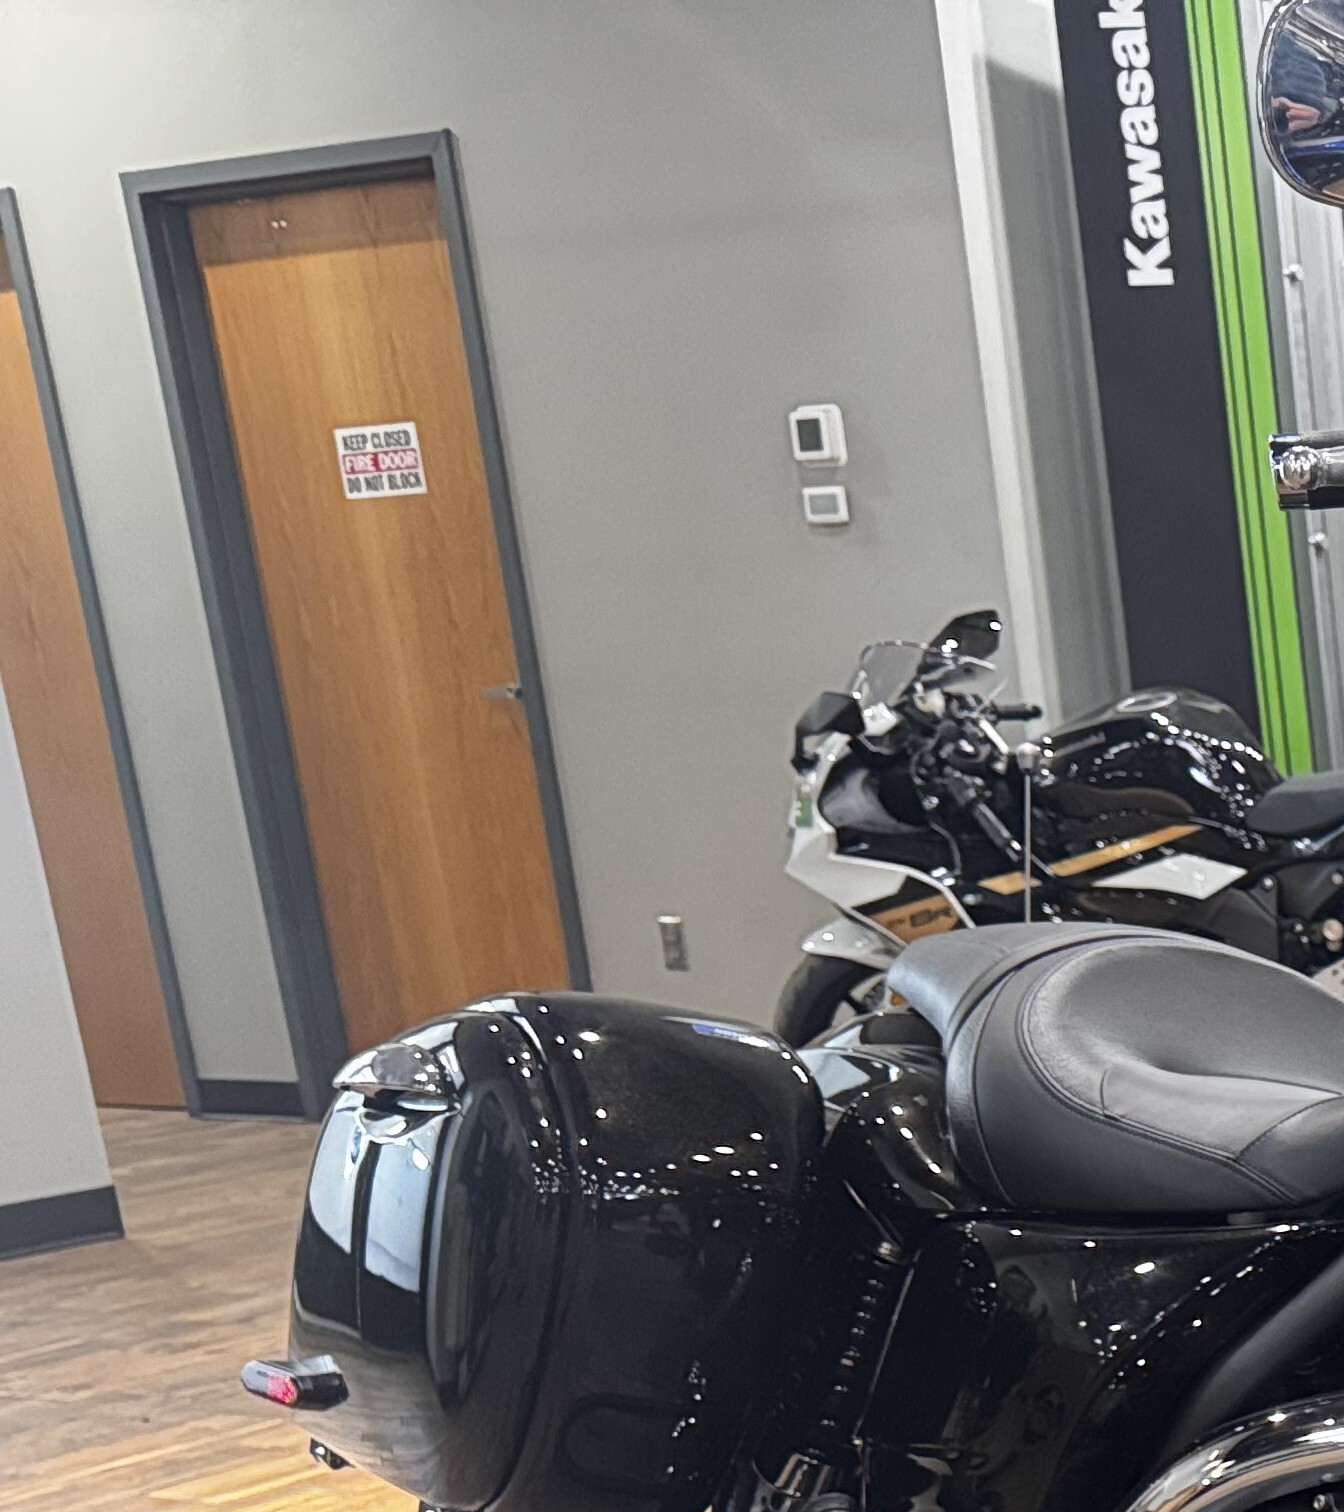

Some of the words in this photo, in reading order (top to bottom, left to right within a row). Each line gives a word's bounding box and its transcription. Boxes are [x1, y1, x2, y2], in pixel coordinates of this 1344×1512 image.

[1098, 0, 1175, 286] Kawasak
[342, 433, 368, 451] KEEP
[371, 430, 412, 449] CLOSED
[345, 454, 377, 473] FIRE
[378, 450, 417, 470] DOOR
[387, 471, 422, 491] BLOCK
